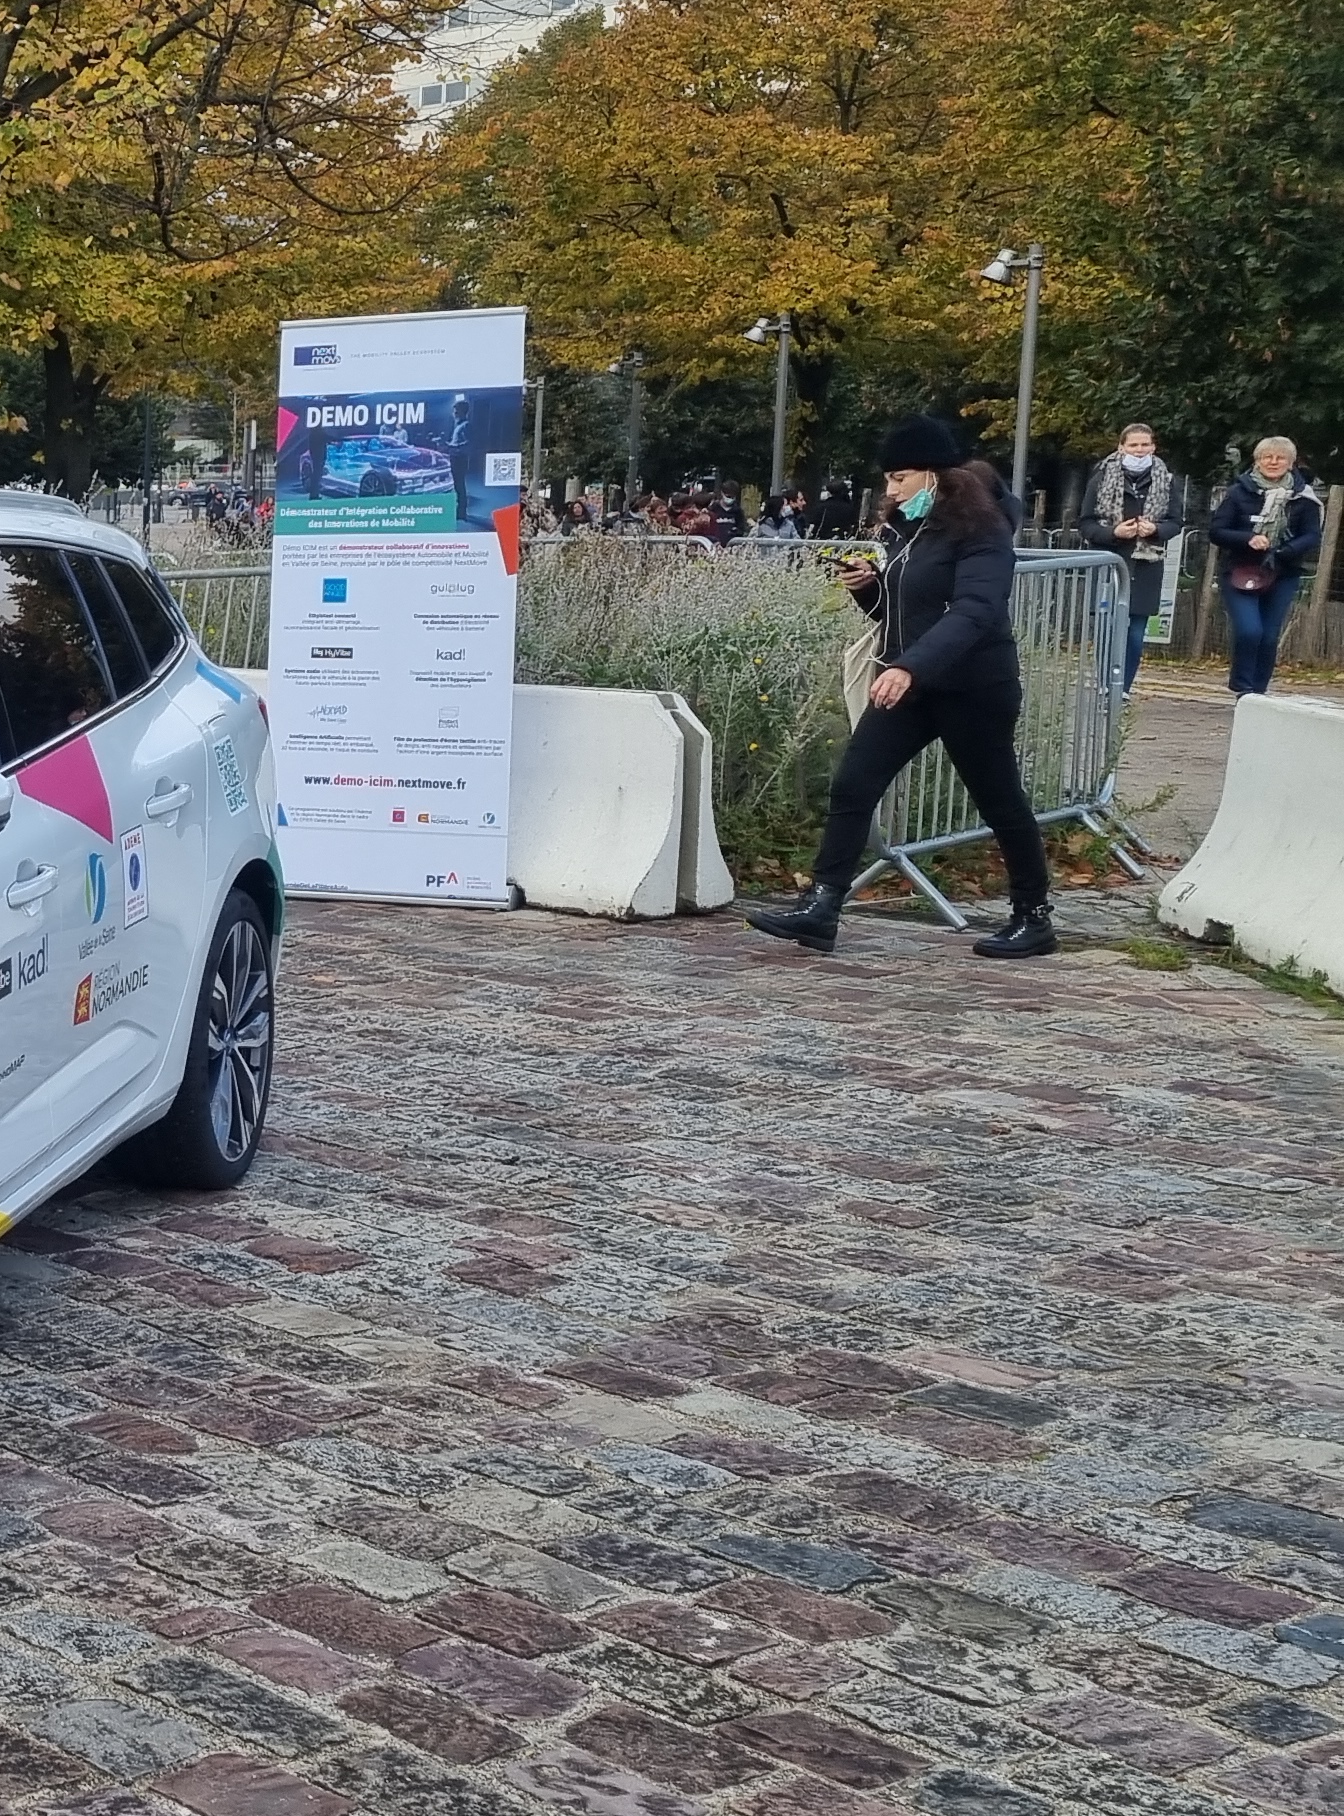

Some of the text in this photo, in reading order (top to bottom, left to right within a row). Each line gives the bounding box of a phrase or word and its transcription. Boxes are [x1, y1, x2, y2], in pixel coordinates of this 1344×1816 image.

[311, 345, 336, 356] next
[312, 354, 342, 364] move
[306, 402, 425, 428] DEMO ICIM
[280, 507, 337, 517] Démonstrateur
[389, 505, 444, 515] Collaborative
[308, 520, 322, 528] des
[370, 519, 380, 527] de
[381, 517, 415, 527] Mobilité
[436, 648, 466, 661] kad!
[304, 773, 467, 790] www.demo-icim.nextmove.fr
[92, 963, 149, 1018] NORMANDIE
